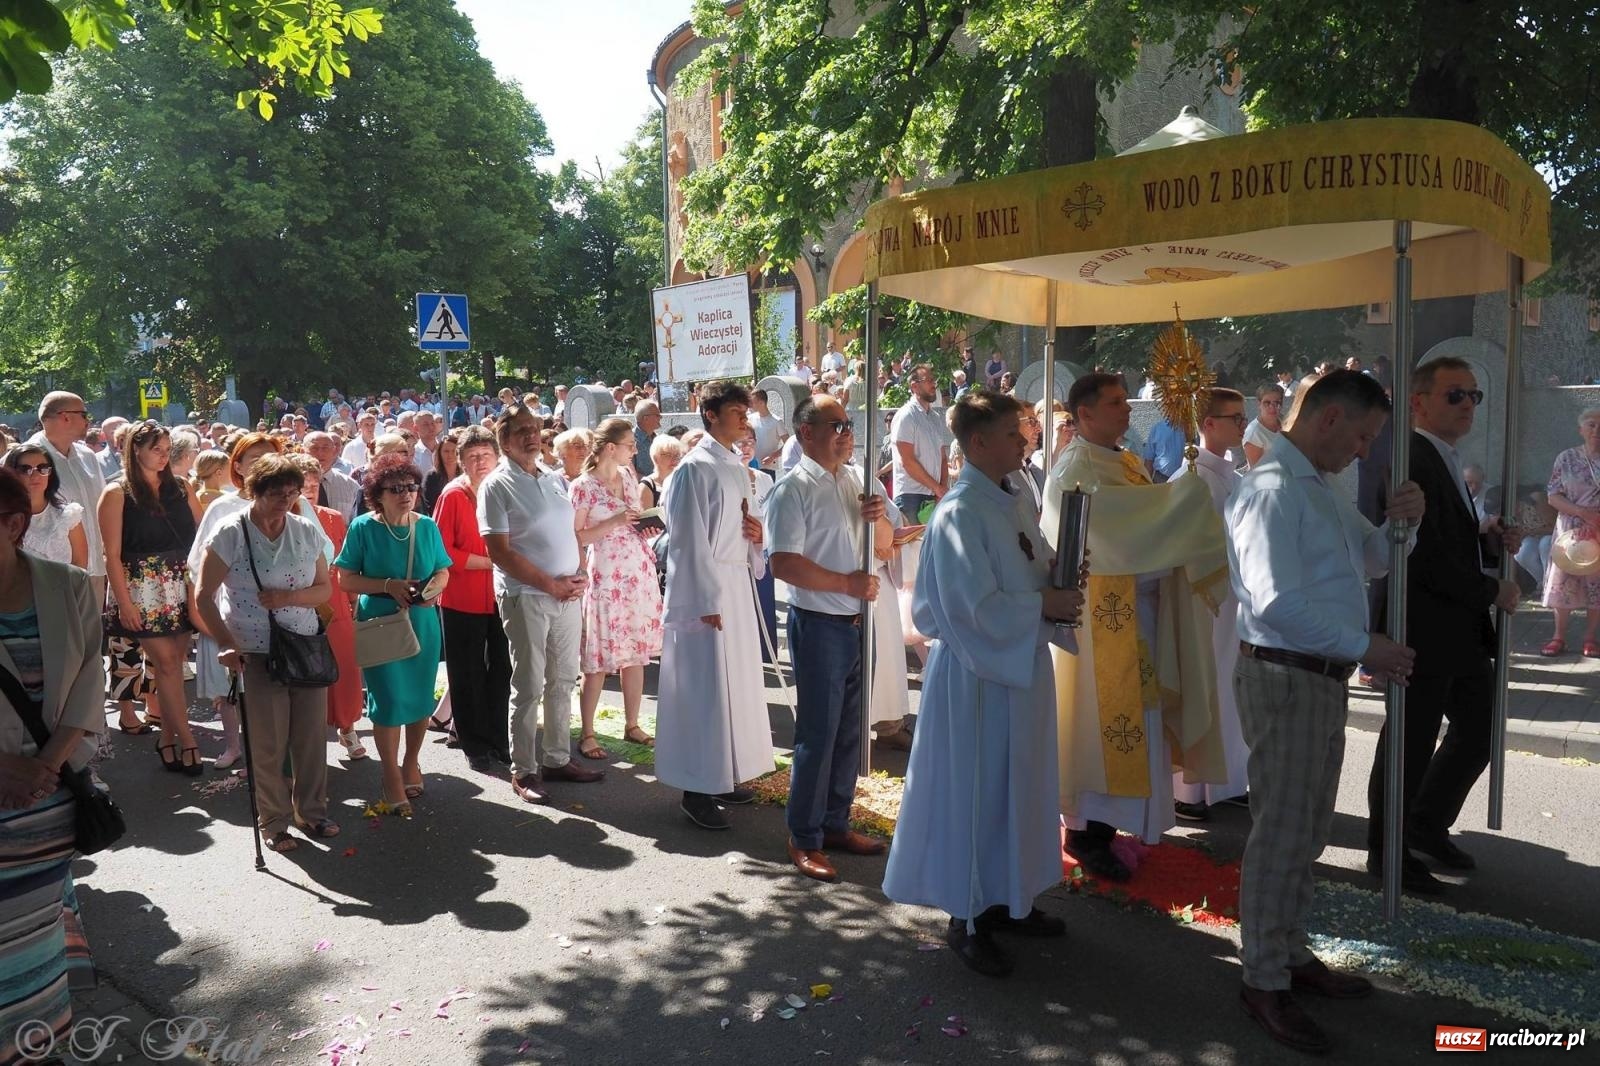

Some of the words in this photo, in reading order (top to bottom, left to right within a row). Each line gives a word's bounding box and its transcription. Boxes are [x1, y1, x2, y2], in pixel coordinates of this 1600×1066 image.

[1143, 174, 1201, 213] WODO
[1210, 171, 1222, 203] Z
[1233, 160, 1293, 201] BOKU
[1304, 152, 1444, 191] CHRYSTUSA
[912, 212, 963, 249] NAPÓJ
[977, 206, 1020, 240] MNIE
[1168, 245, 1209, 256] MNIE
[697, 308, 733, 325] Kaplica
[690, 322, 743, 341] Wieczystej
[698, 340, 738, 357] Adoracji
